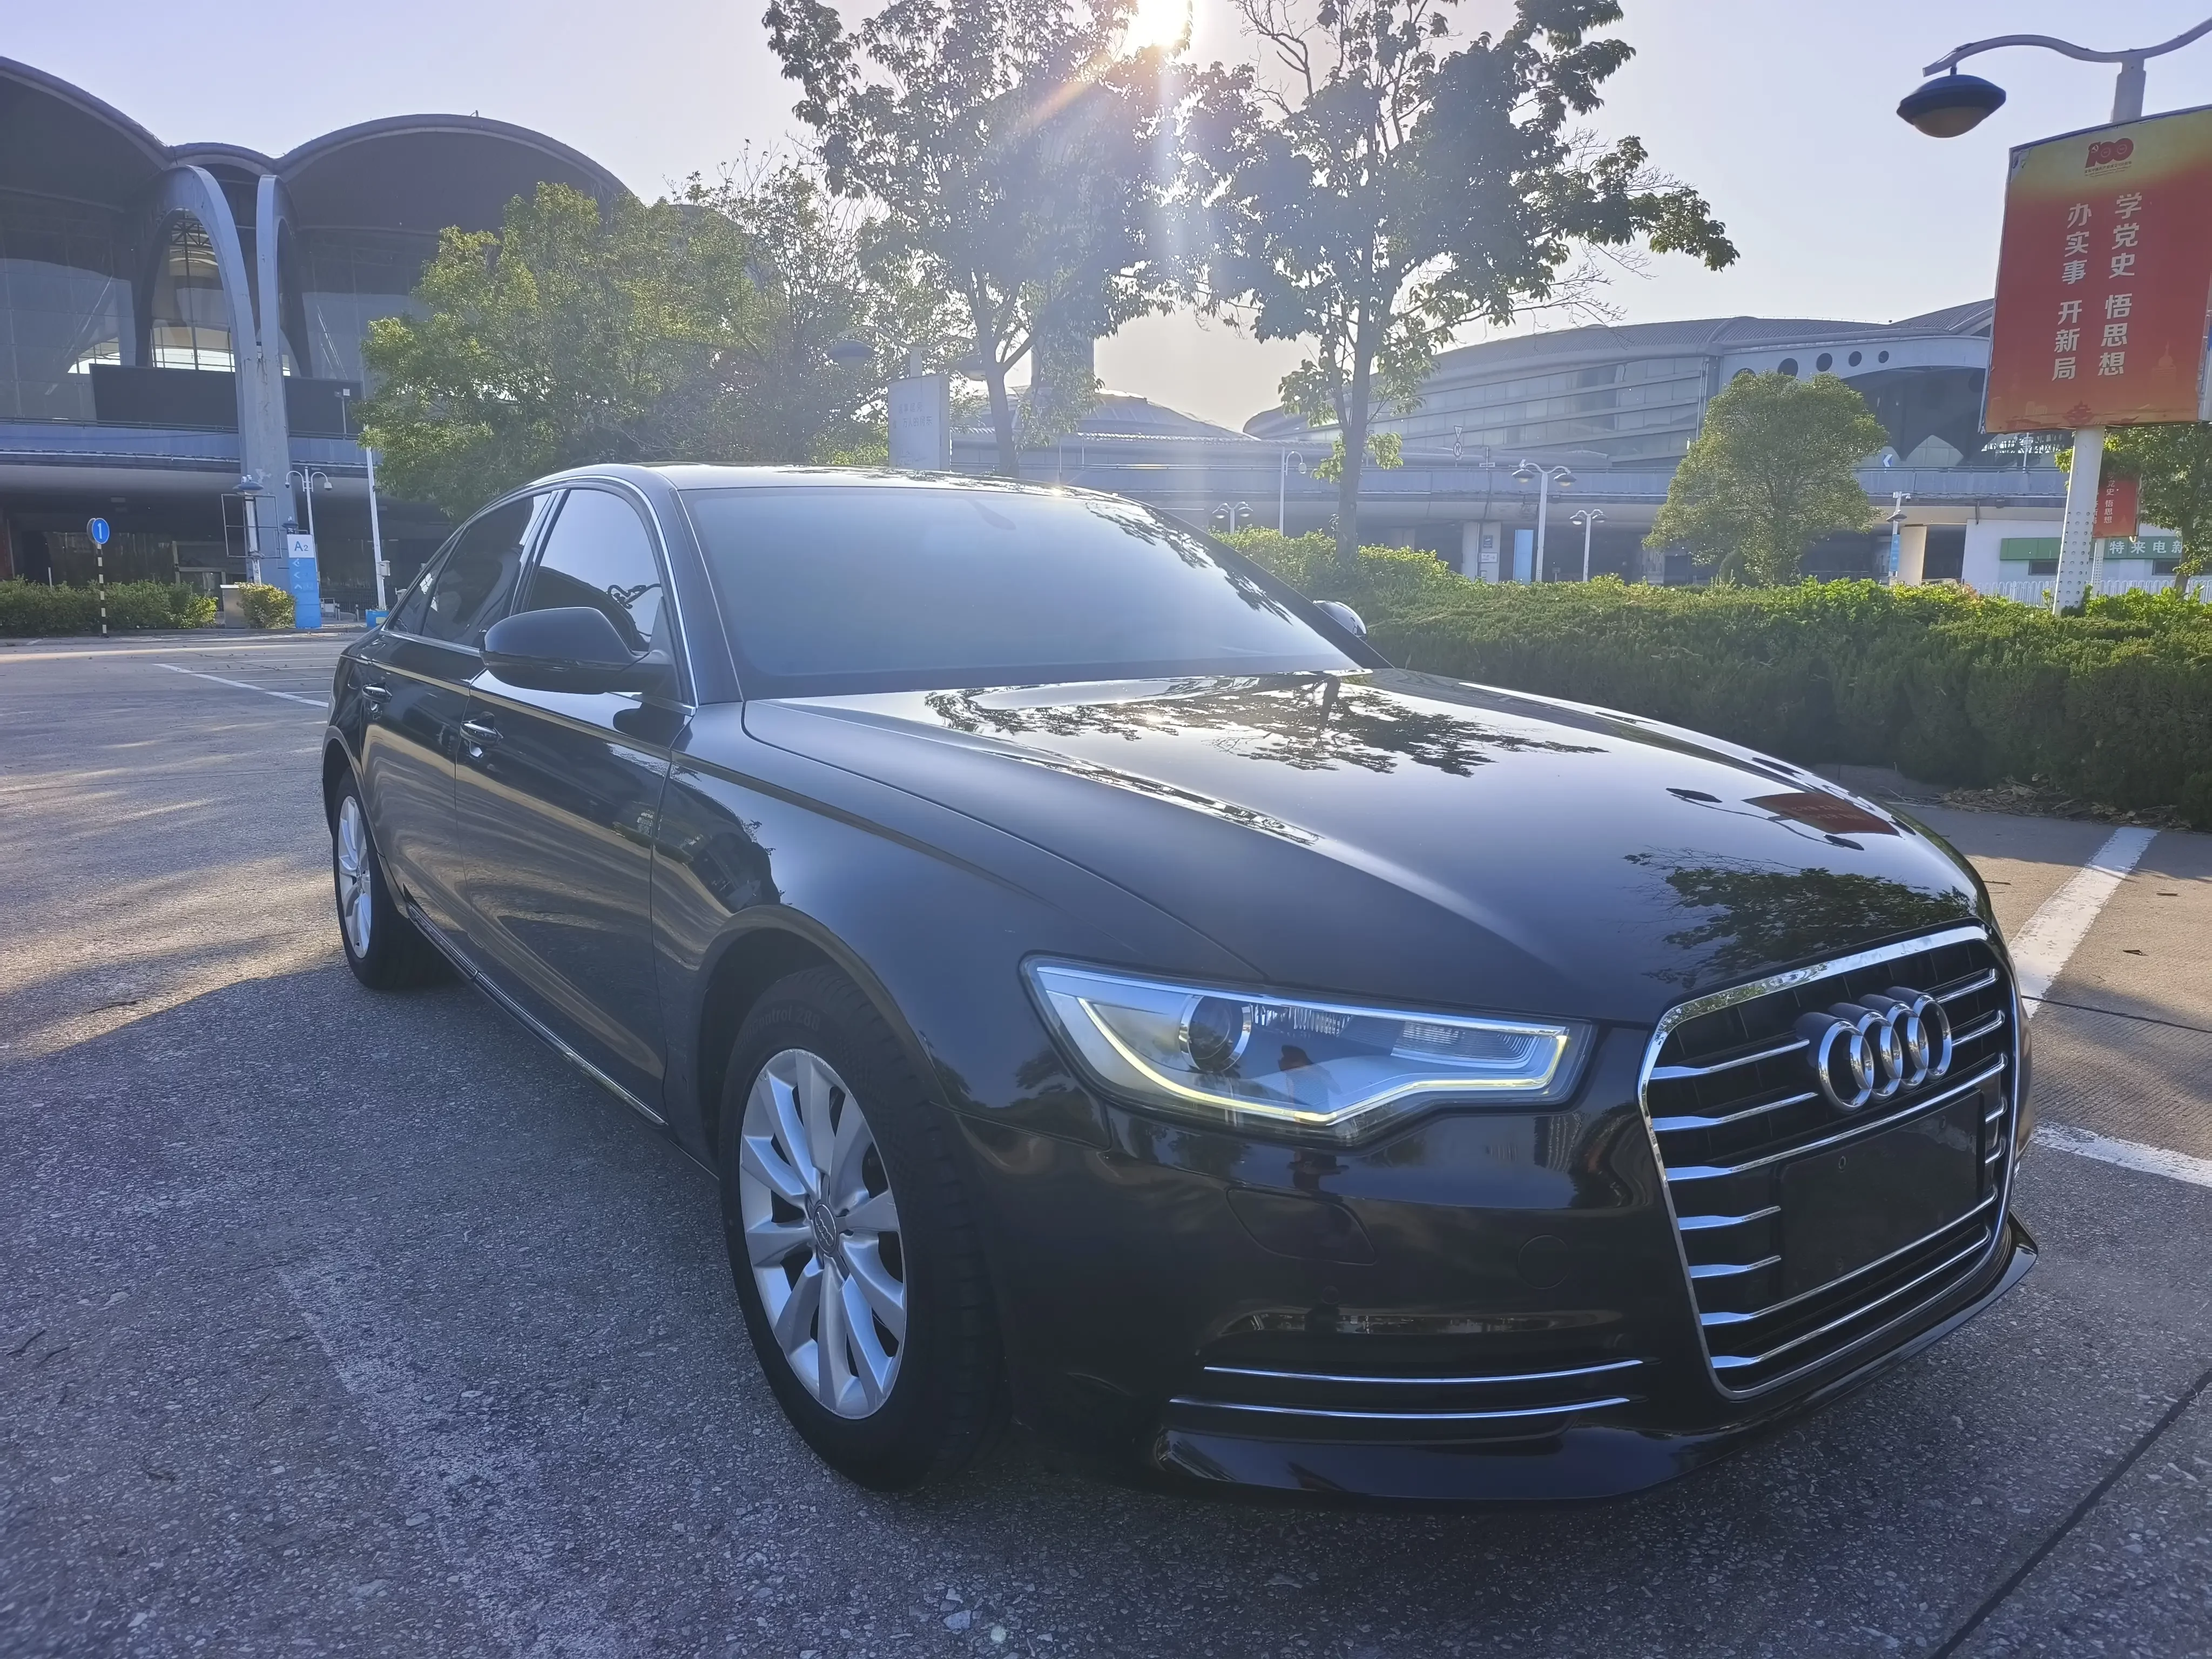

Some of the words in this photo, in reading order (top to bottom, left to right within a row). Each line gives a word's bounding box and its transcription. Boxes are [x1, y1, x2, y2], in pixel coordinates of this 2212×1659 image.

[2061, 203, 2092, 285] 办实事
[2109, 192, 2142, 279] 学党史
[2052, 300, 2082, 381] 开新局
[2098, 293, 2133, 376] 悟思想
[293, 541, 309, 552] A2
